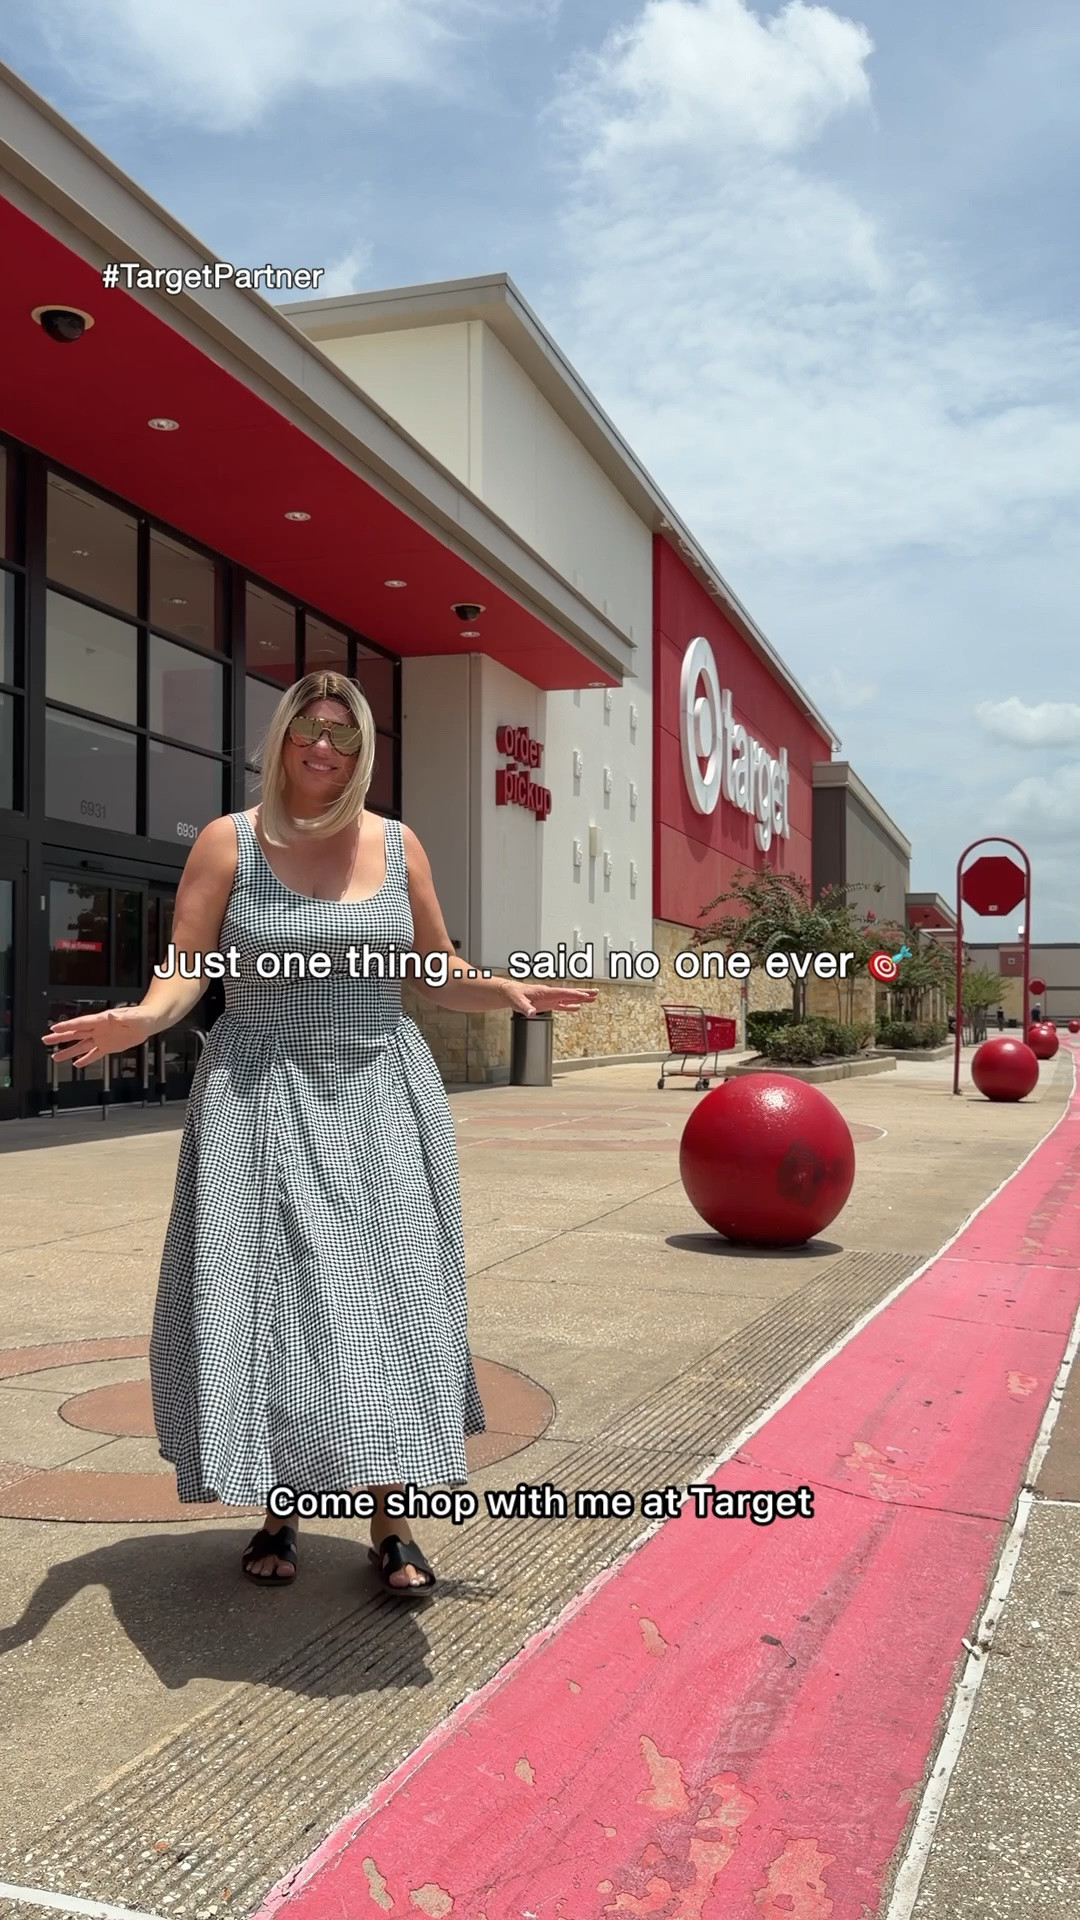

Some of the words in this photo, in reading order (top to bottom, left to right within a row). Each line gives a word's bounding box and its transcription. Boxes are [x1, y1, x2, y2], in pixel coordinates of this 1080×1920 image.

[496, 726, 544, 768] order
[722, 688, 790, 851] target
[80, 799, 106, 819] 6931
[496, 763, 552, 821] pickup
[176, 821, 198, 839] 6931
